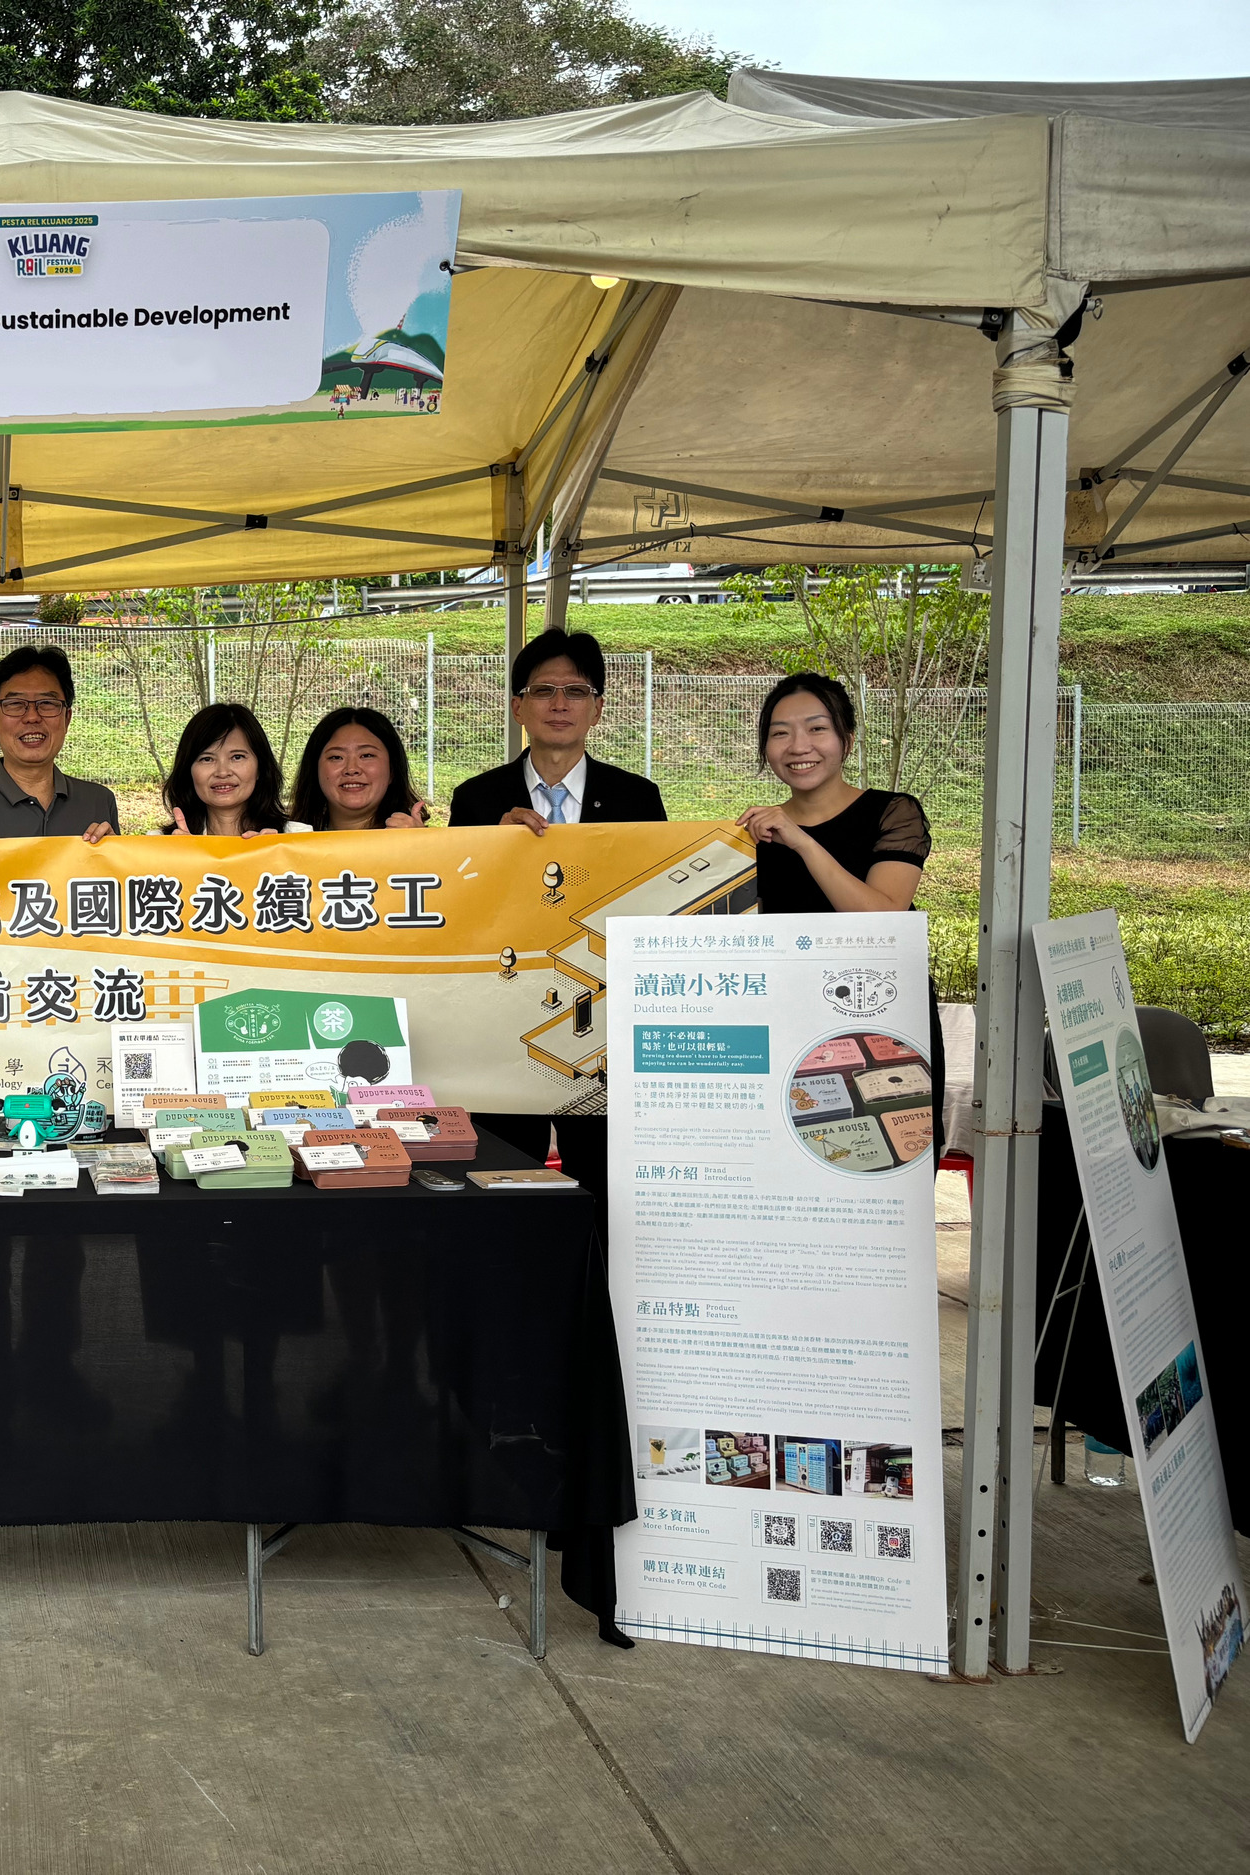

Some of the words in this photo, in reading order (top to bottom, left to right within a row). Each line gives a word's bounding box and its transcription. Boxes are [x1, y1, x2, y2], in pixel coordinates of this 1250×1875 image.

[7, 233, 90, 258] KLUANG
[47, 258, 81, 266] FESTIVAL
[133, 302, 291, 331] Development
[632, 934, 775, 949] 雲林科技大學永續發展
[633, 972, 768, 997] 讀讀小茶屋
[634, 1003, 678, 1014] Dudutea
[680, 1003, 714, 1013] House
[321, 1008, 345, 1033] 茶
[96, 1080, 113, 1089] Ce
[300, 1093, 326, 1101] HOUSE
[358, 1090, 395, 1098] DUDUTEA
[398, 1089, 425, 1097] HOUSE
[166, 1113, 204, 1121] DUDUTEA
[273, 1112, 312, 1121] DUDUTEA
[316, 1112, 344, 1120] HOUSE
[430, 1110, 459, 1118] HOUSE
[891, 1112, 932, 1126] DUDUTEA
[202, 1134, 243, 1143] DUDUTEA
[246, 1134, 277, 1142] HOUSE
[316, 1134, 357, 1142] DUDUTEA
[360, 1132, 390, 1140] HOUSE
[635, 1165, 698, 1181] 品牌介紹
[704, 1166, 726, 1174] Brand
[704, 1174, 752, 1182] Introduction
[636, 1300, 700, 1317] 產品特點
[706, 1303, 735, 1311] Product
[706, 1311, 739, 1320] Features
[643, 1507, 697, 1523] 更多資訊
[664, 1524, 710, 1535] Information
[643, 1559, 726, 1580] 購買表單連結
[643, 1575, 674, 1585] Purchase
[677, 1578, 695, 1586] Form
[697, 1580, 707, 1588] QR
[709, 1581, 727, 1590] Code
